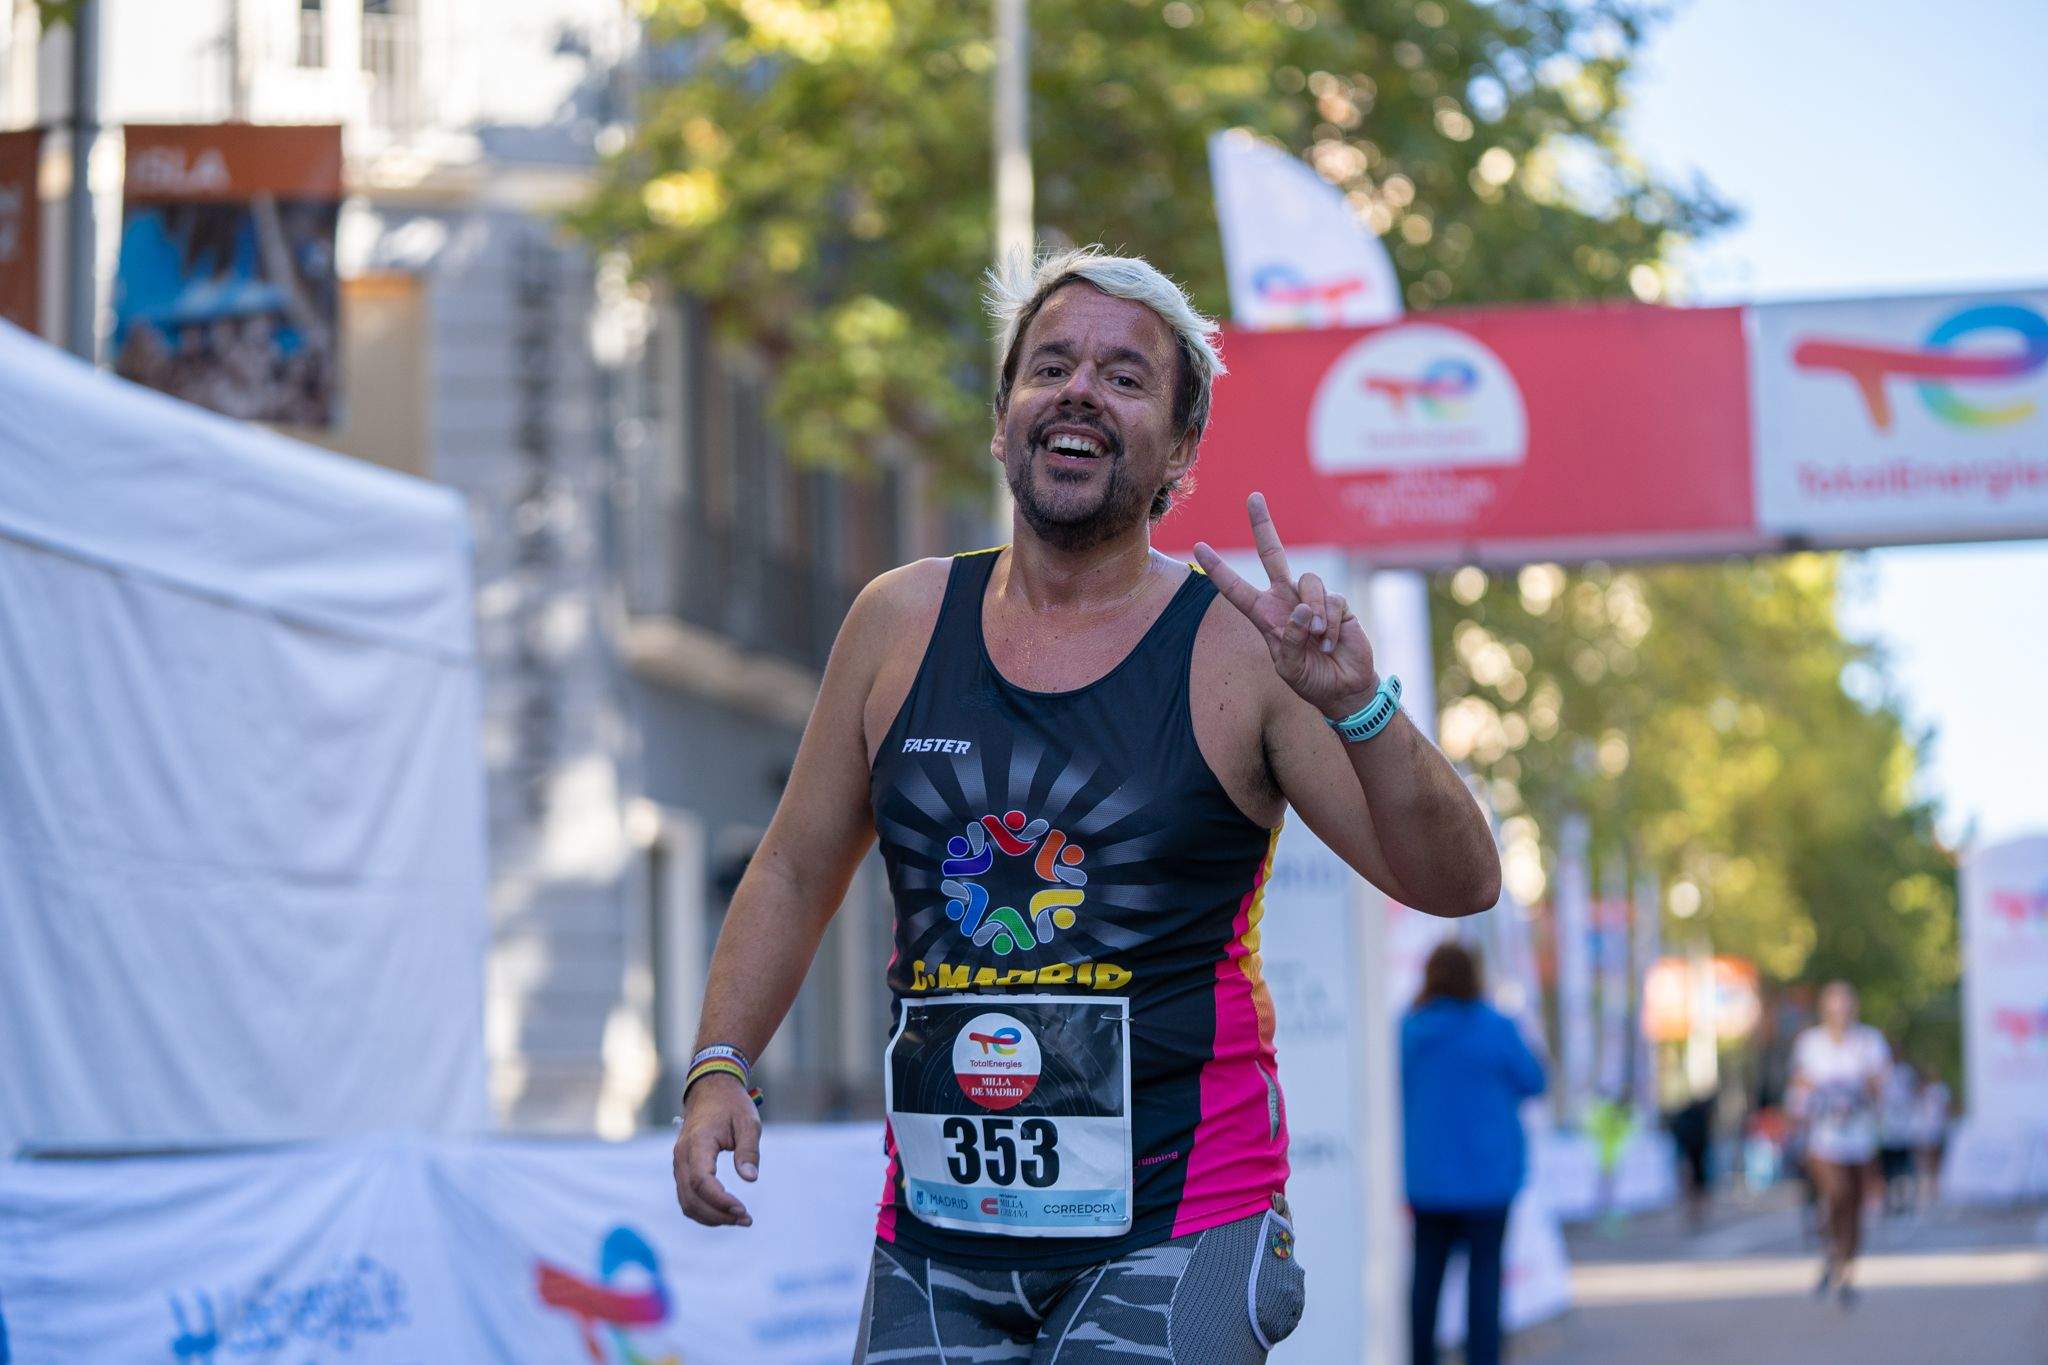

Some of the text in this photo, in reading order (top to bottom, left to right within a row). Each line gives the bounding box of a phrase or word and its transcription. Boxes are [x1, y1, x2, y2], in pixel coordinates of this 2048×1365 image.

[902, 738, 972, 755] FASTER
[969, 1059, 1023, 1070] TotalEnergies
[981, 1077, 1012, 1087] MILLA
[970, 1087, 1024, 1097] DE MADRID
[943, 1116, 1060, 1188] 353
[929, 1193, 969, 1210] MADRID
